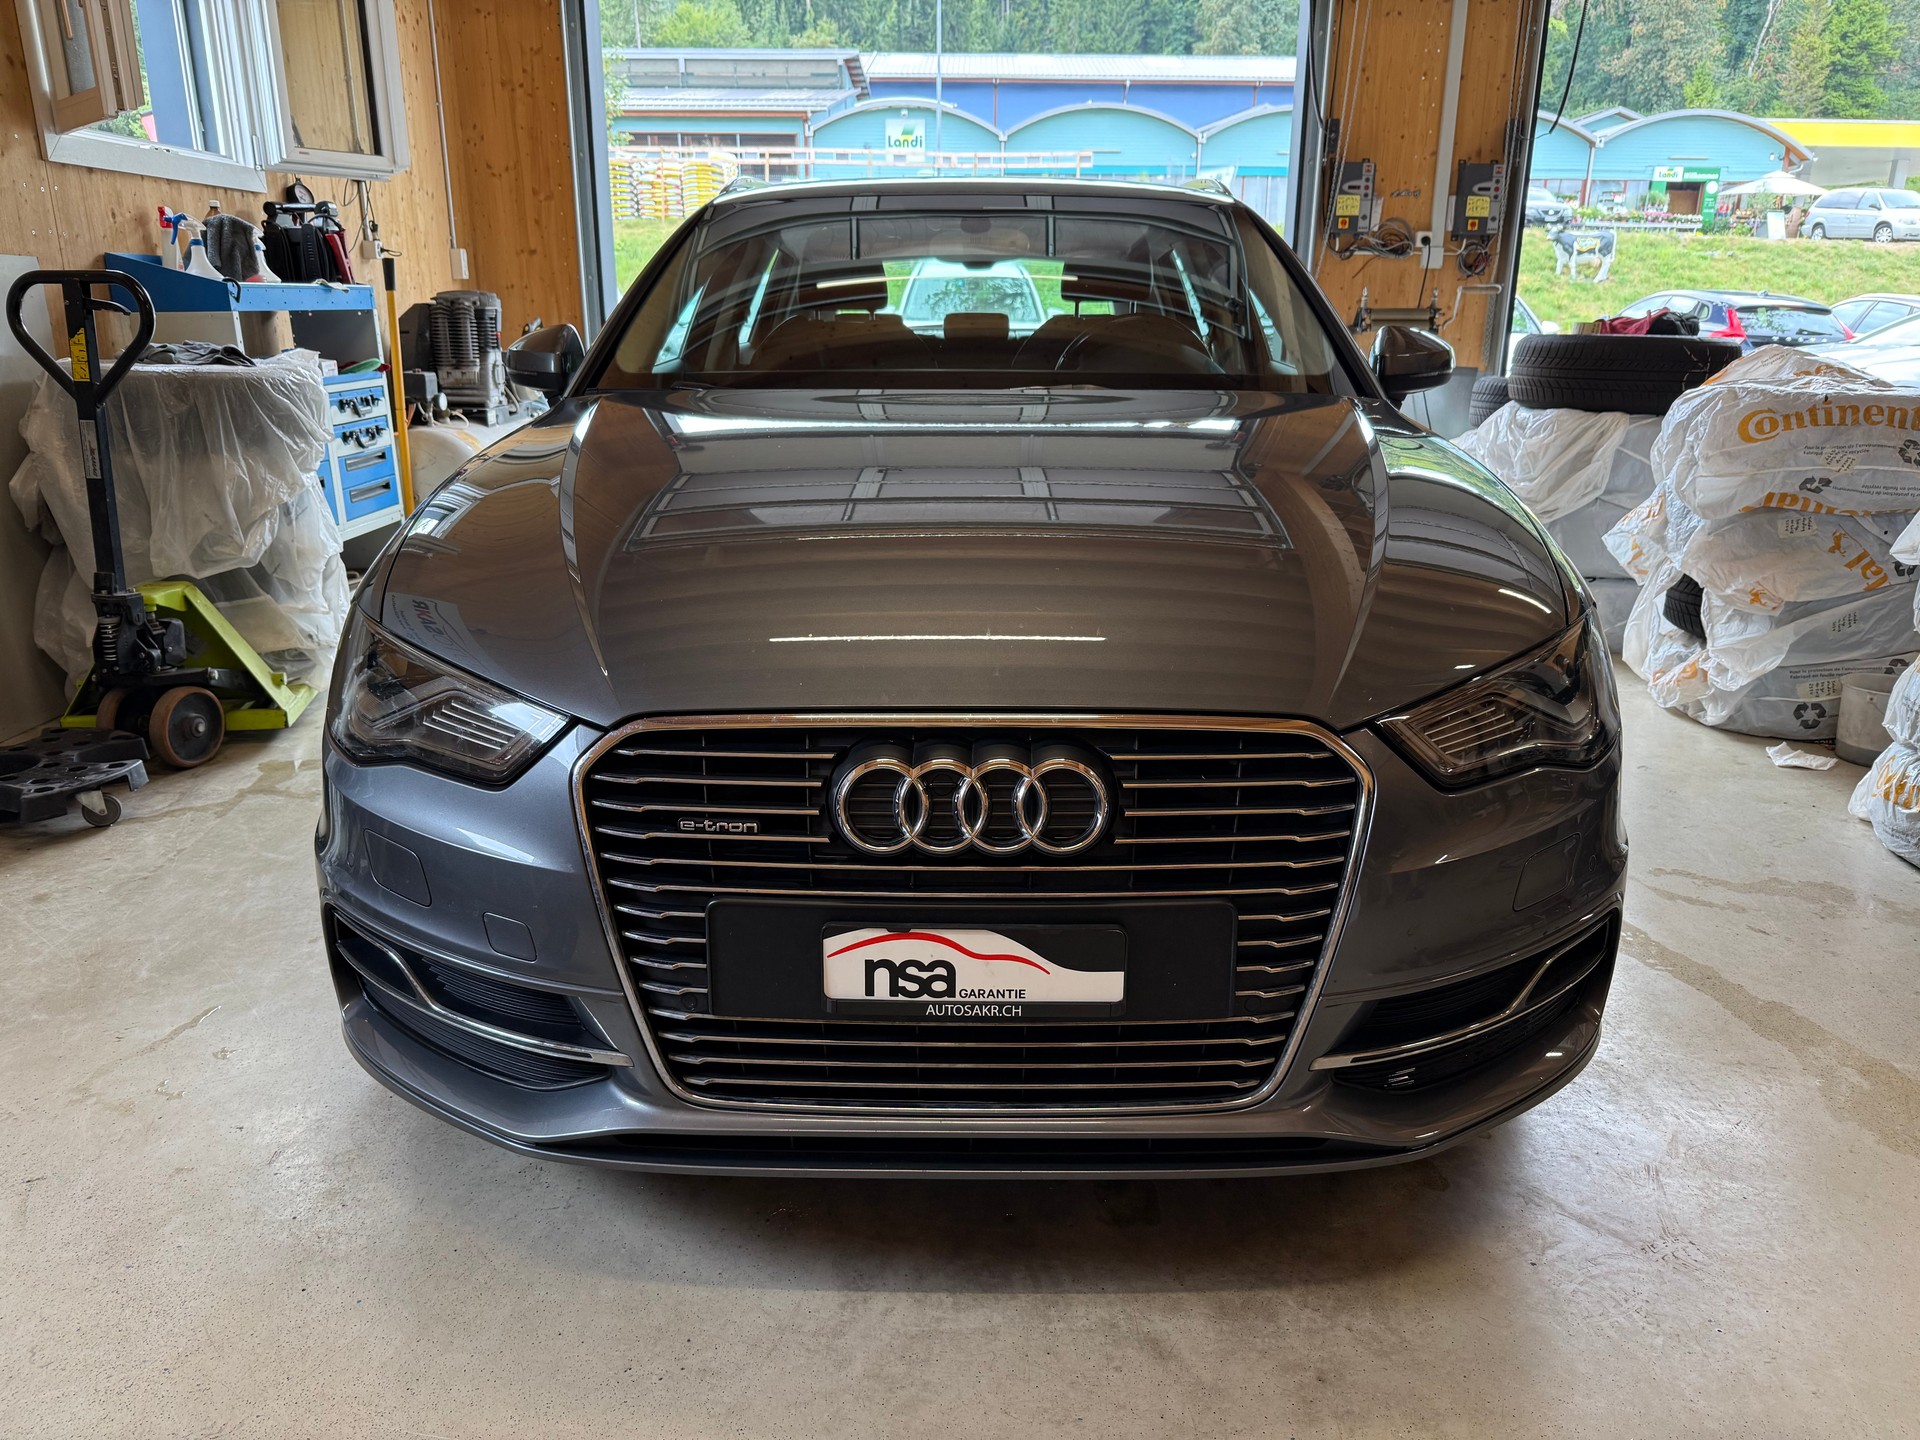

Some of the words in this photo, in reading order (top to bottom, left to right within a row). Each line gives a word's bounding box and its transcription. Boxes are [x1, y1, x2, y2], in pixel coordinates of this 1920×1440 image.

[888, 135, 923, 148] Landi
[680, 819, 758, 833] e-tron
[864, 958, 957, 999] nsa
[958, 988, 1026, 999] GARANTIE
[925, 1003, 1022, 1017] AUTOSAKR.CH
